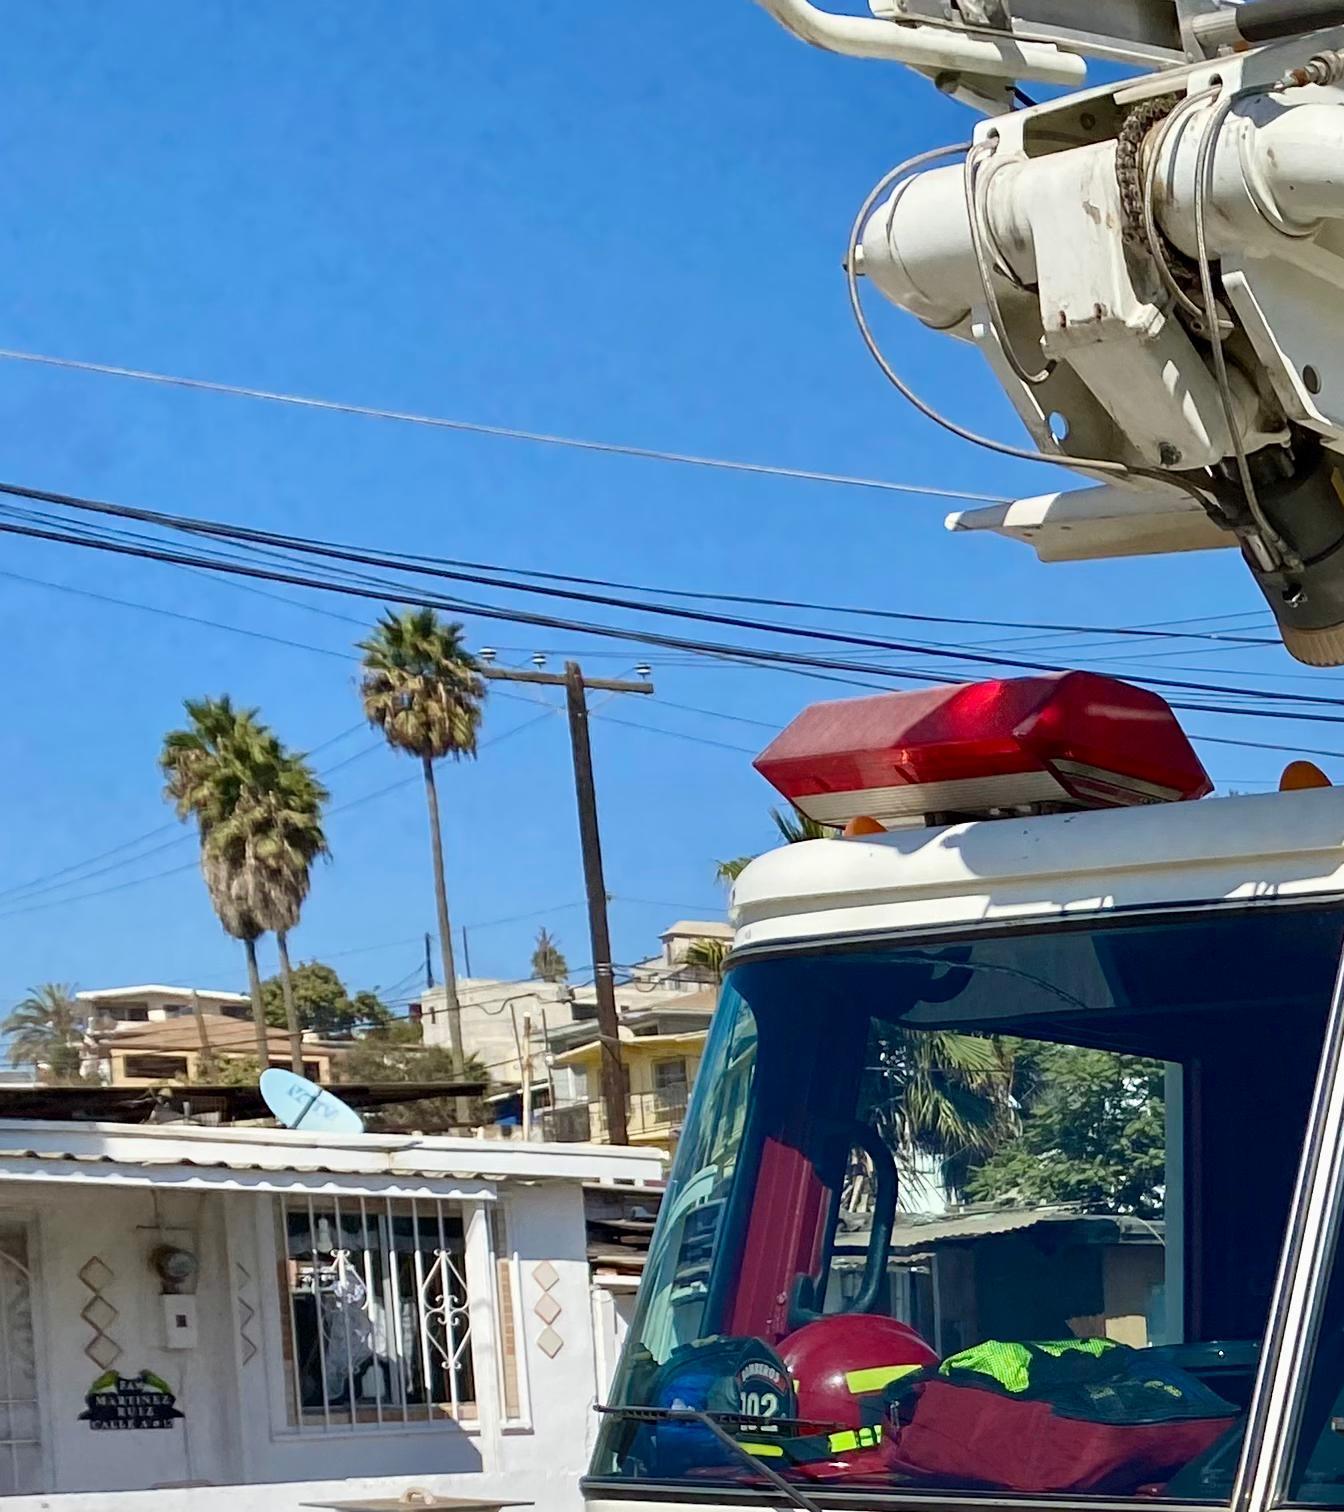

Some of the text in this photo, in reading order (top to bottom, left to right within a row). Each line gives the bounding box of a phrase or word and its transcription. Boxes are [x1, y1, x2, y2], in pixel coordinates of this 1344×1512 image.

[95, 1395, 170, 1406] MARTINEZ
[117, 1406, 155, 1417] RUIZ
[740, 1391, 779, 1432] 102
